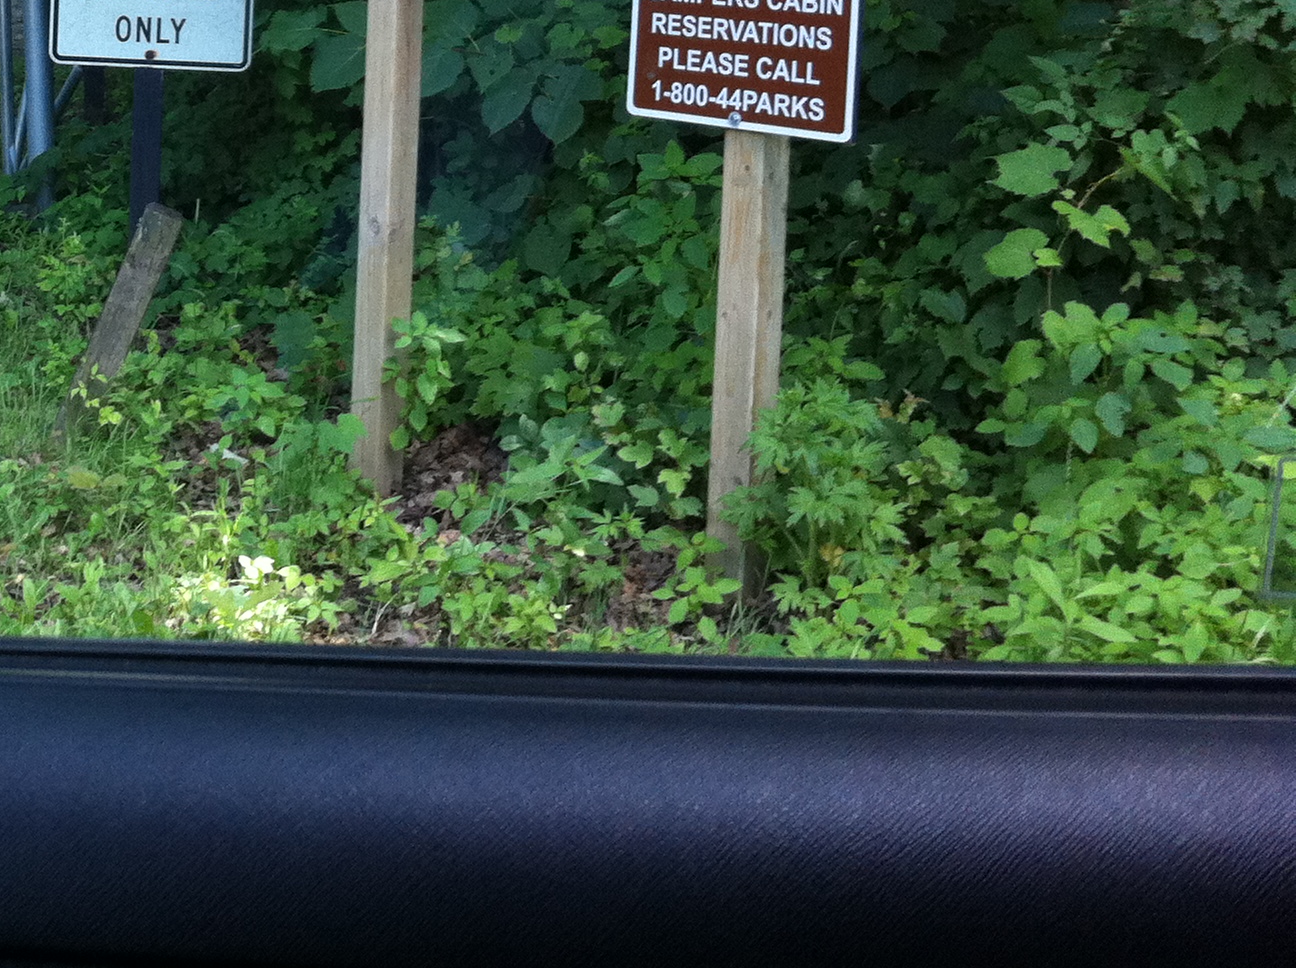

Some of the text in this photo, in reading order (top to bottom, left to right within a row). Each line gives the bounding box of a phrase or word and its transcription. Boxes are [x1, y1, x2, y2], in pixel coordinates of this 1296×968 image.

[115, 15, 186, 44] ONLY
[651, 12, 833, 50] RESERVATIONS
[657, 46, 821, 85] PLEASE CALL
[651, 79, 825, 122] 1-800-44PARKS
